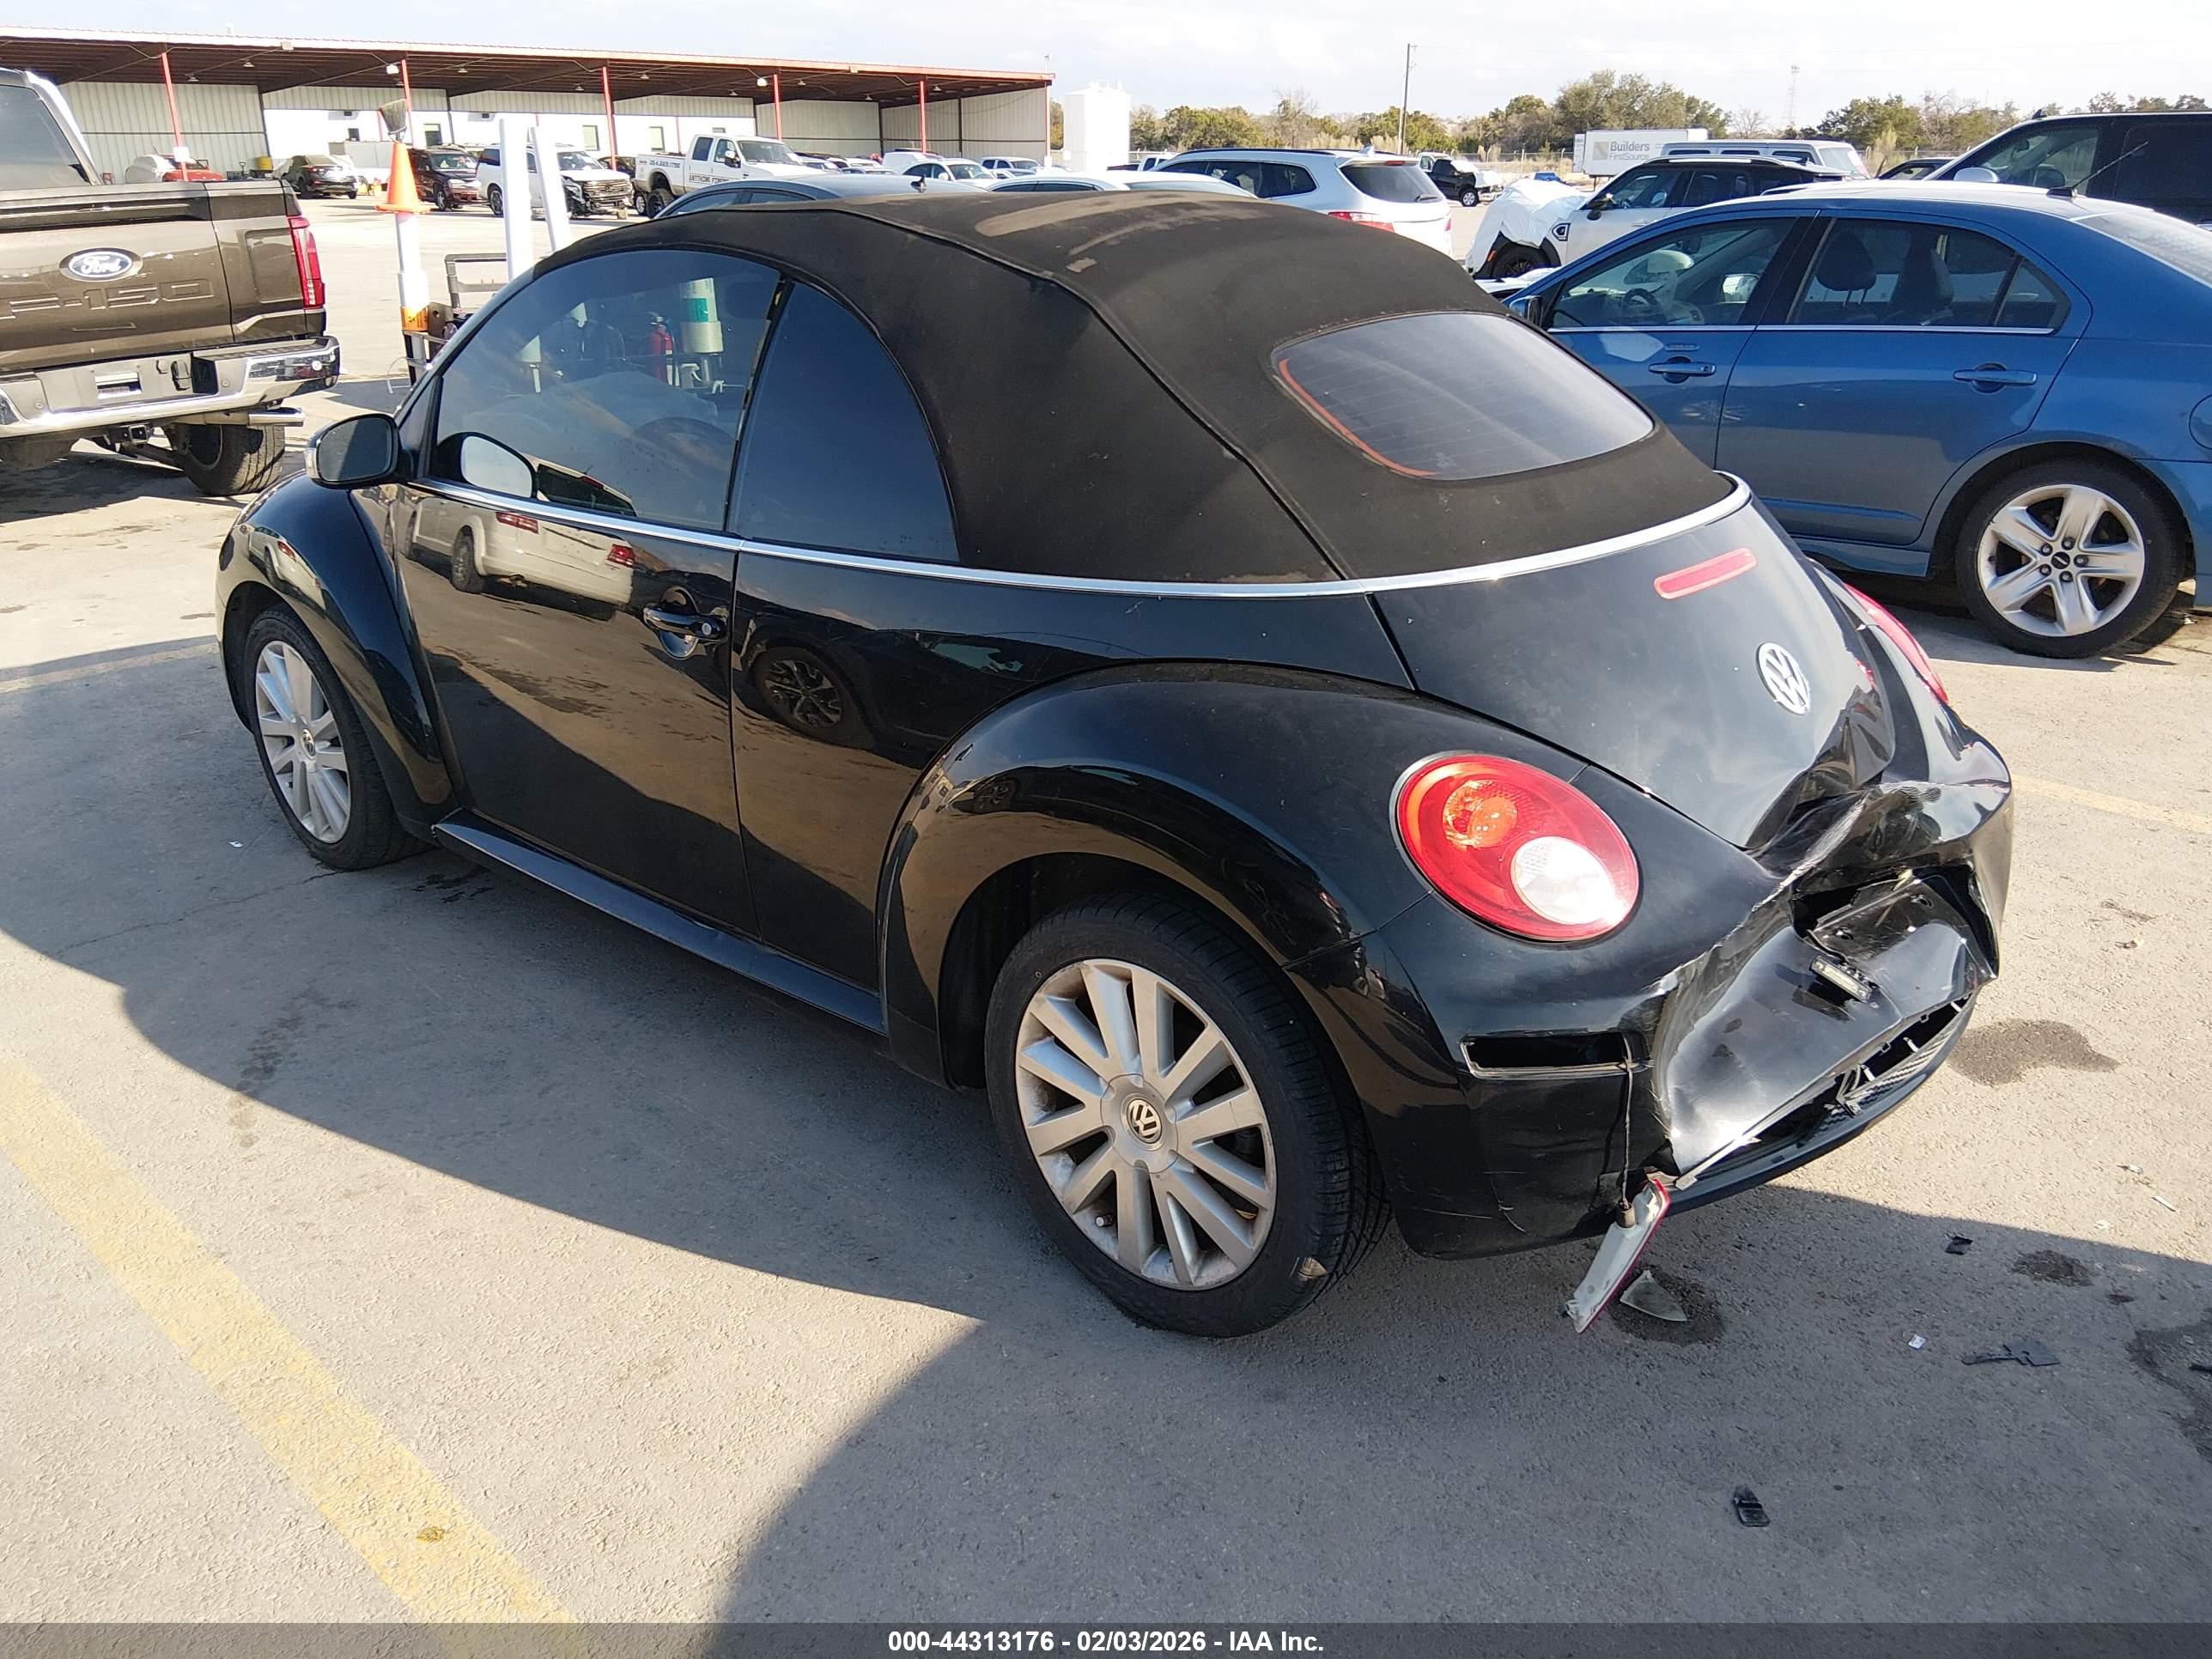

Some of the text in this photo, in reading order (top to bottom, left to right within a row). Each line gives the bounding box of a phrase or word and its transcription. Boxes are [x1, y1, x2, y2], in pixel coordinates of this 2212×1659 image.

[1609, 140, 1650, 152] Builders
[1608, 152, 1650, 161] FirstSource
[80, 254, 122, 275] Ford
